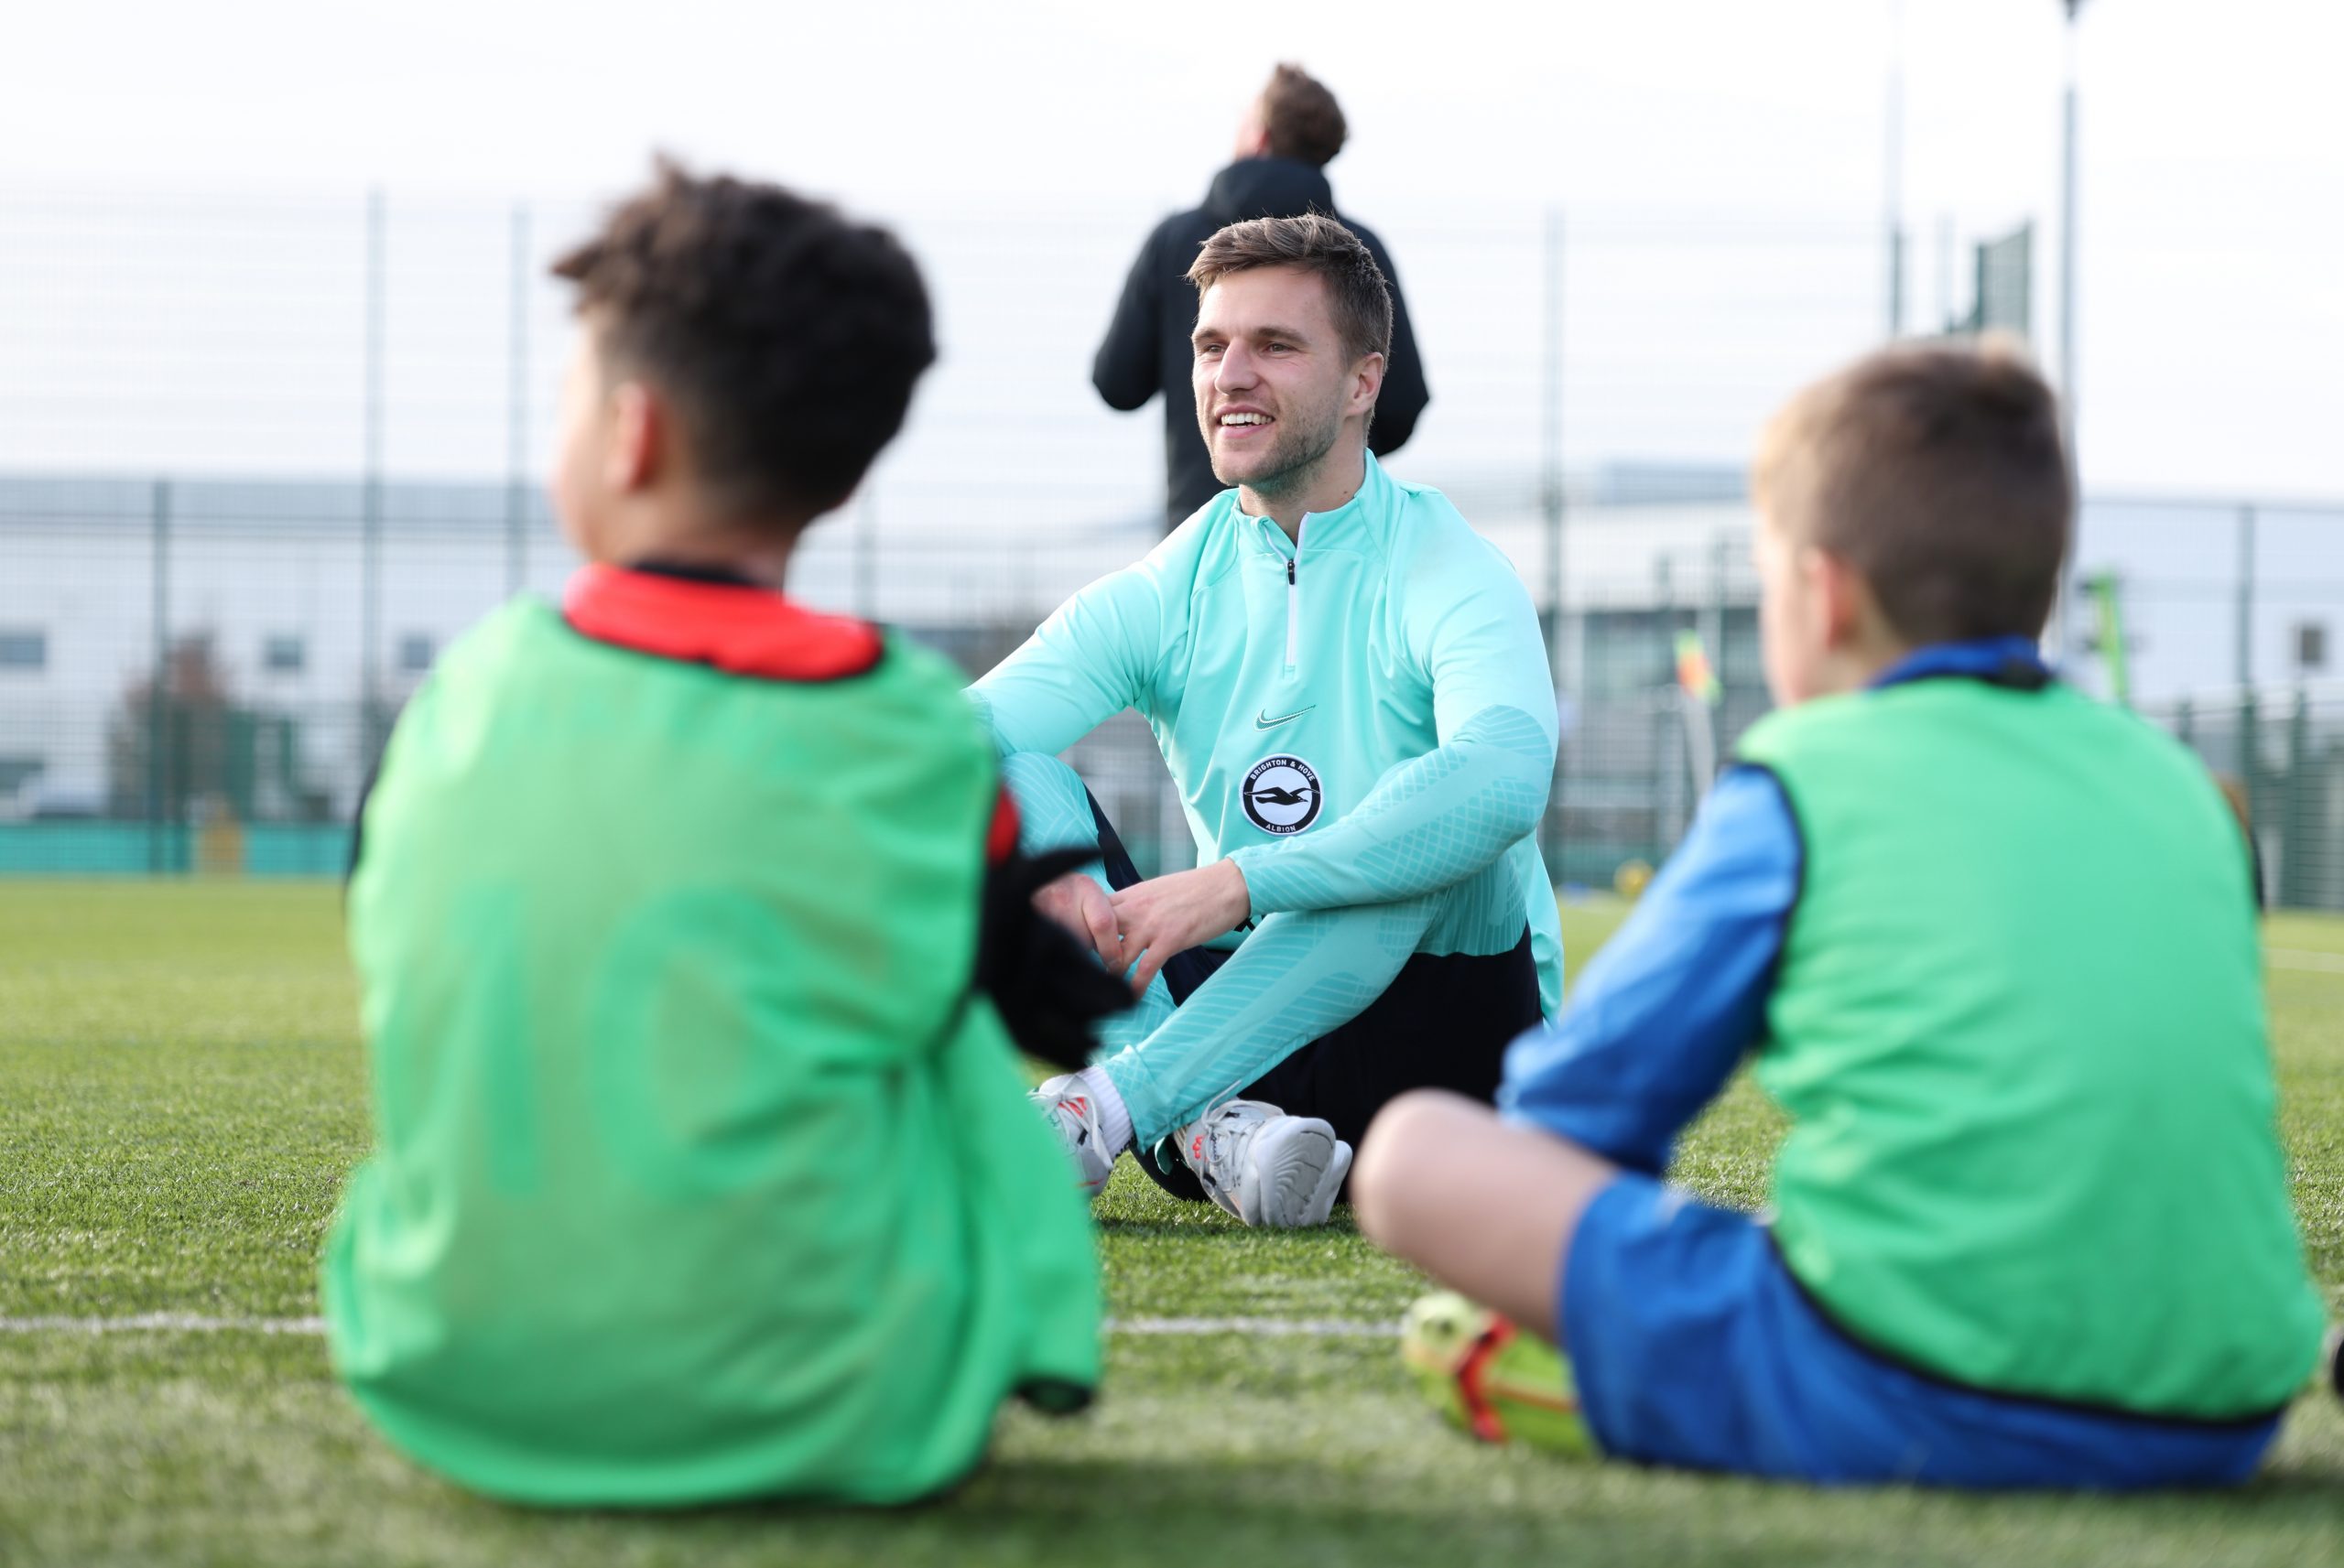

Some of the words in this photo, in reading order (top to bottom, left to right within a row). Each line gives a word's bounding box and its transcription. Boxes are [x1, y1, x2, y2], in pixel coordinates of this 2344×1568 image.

[1250, 759, 1286, 780] BRIGHTON
[1297, 764, 1316, 782] HOVE
[1265, 824, 1297, 832] ALBION
